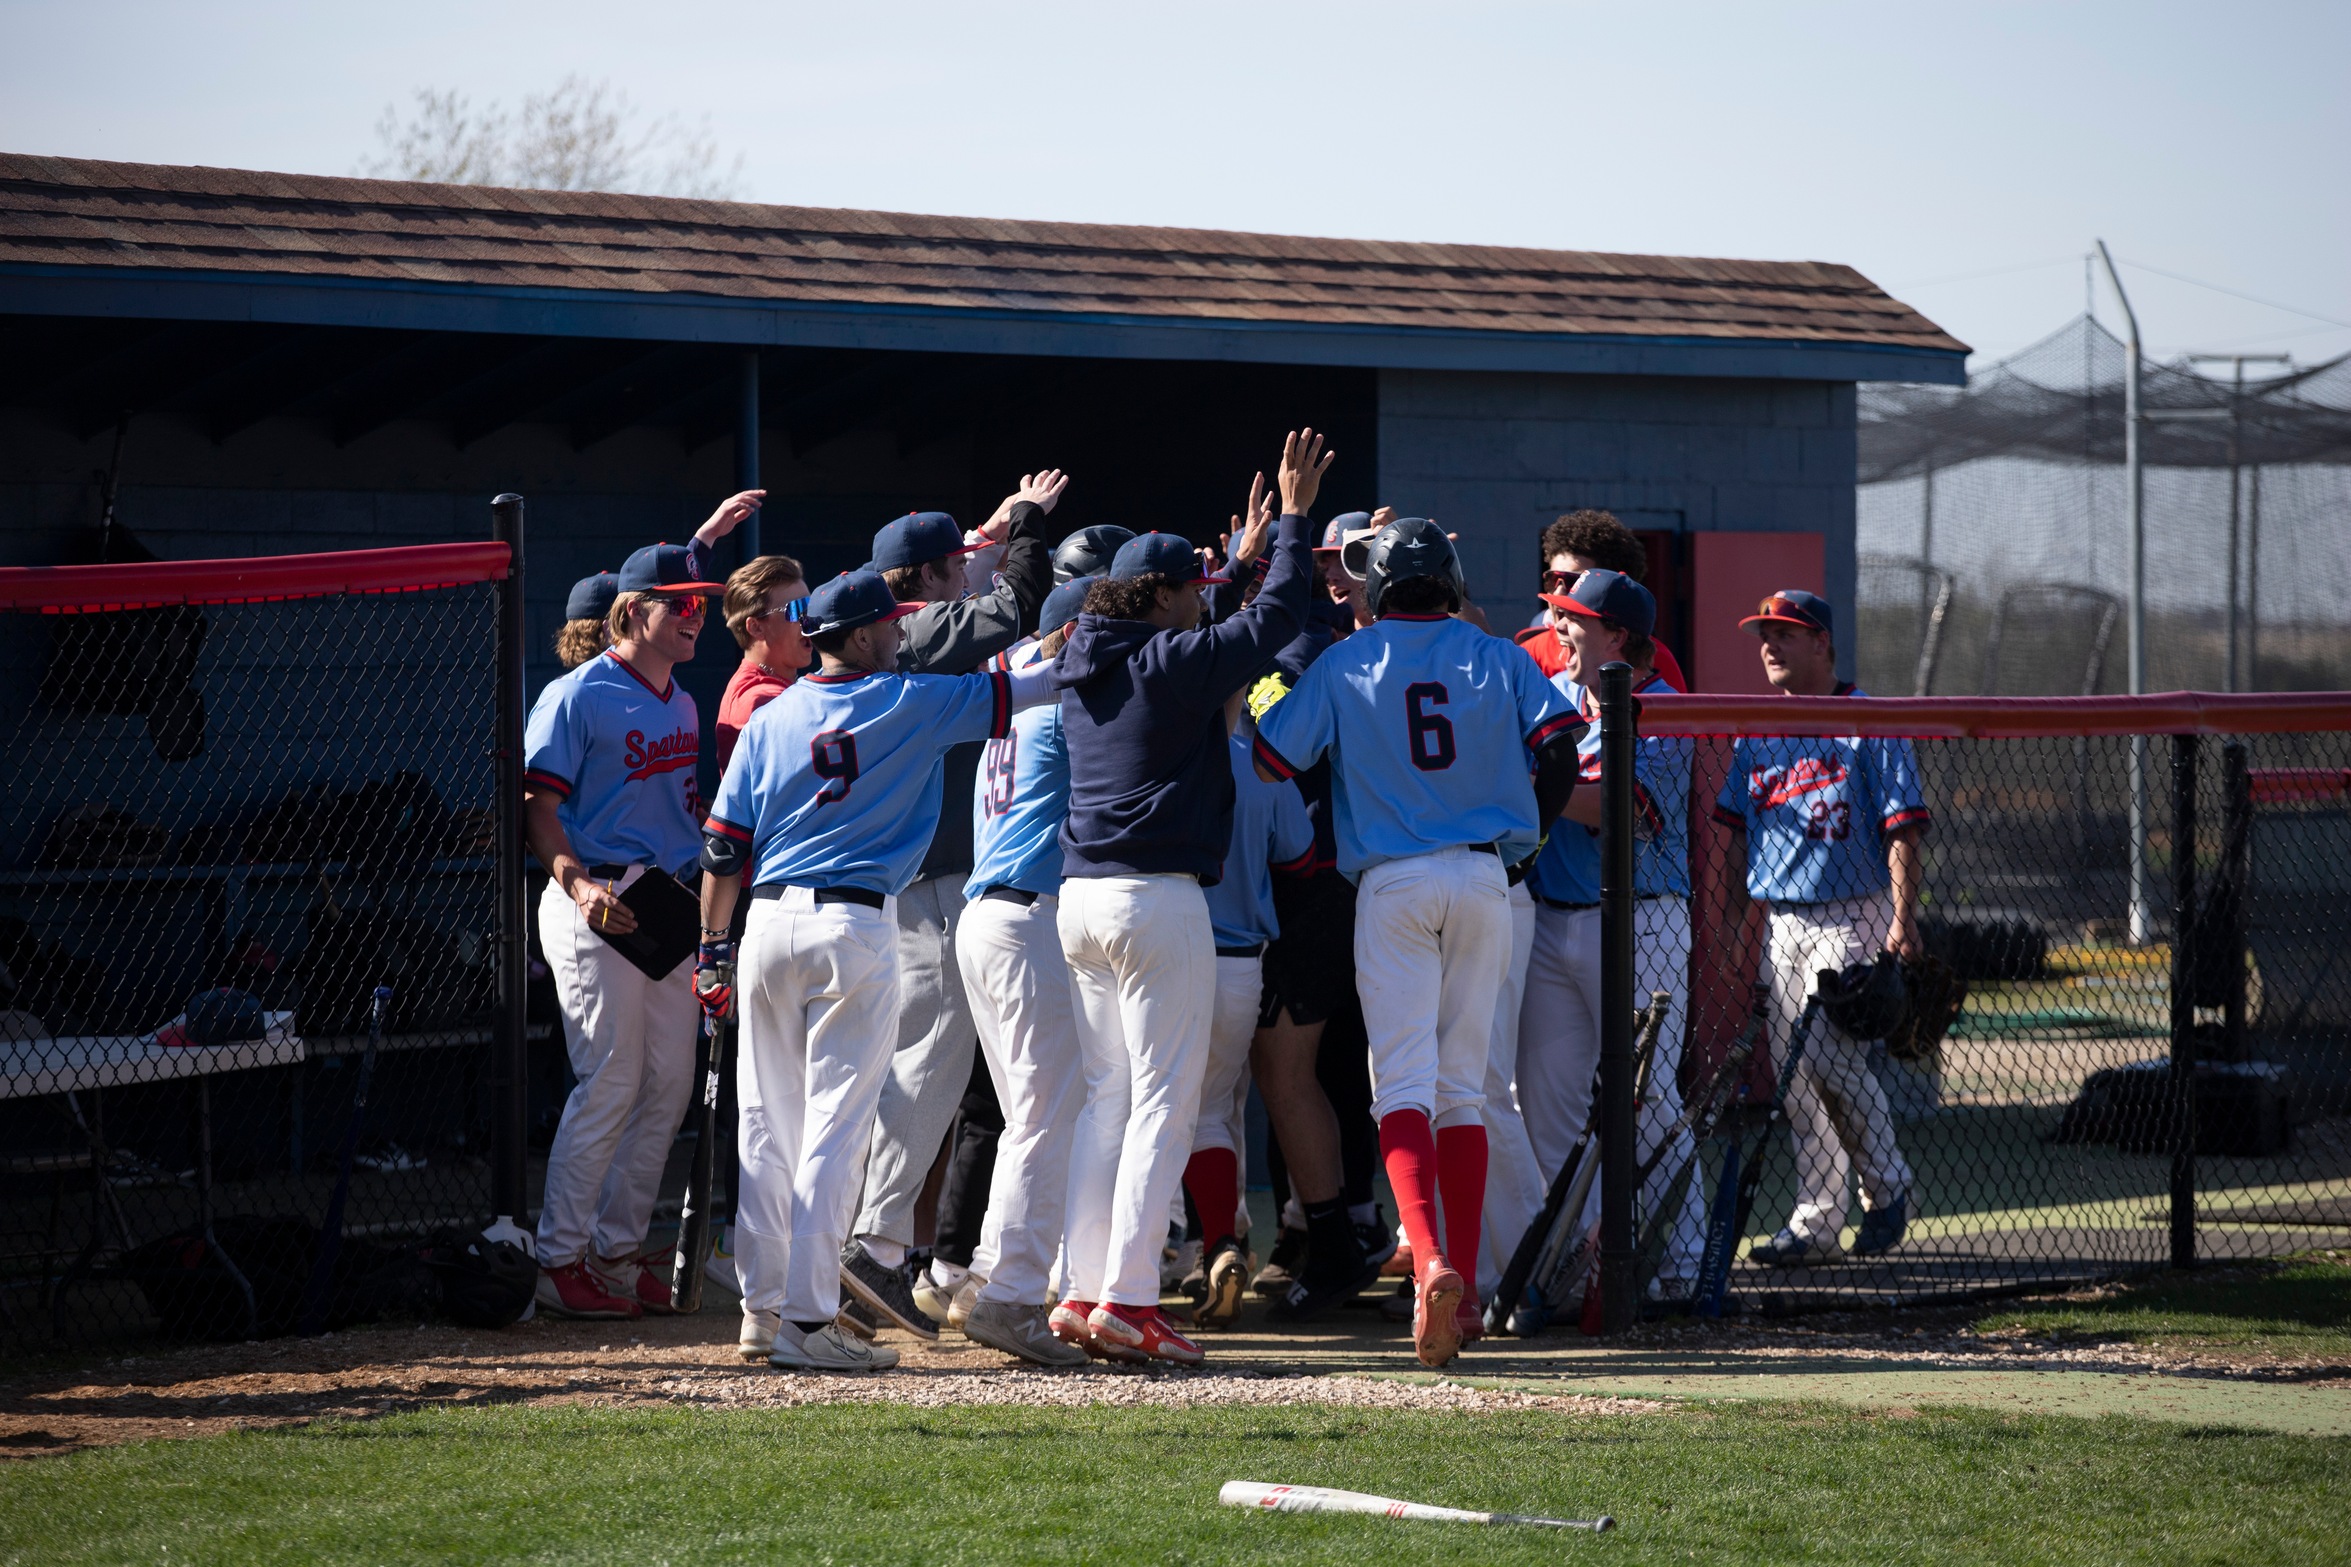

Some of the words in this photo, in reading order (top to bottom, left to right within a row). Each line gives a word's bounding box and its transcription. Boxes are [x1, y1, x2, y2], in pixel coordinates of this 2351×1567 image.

[1405, 681, 1457, 772] 6
[682, 776, 699, 817] 3
[811, 729, 860, 808] 9
[984, 727, 1018, 821] 99
[1807, 801, 1851, 841] 23
